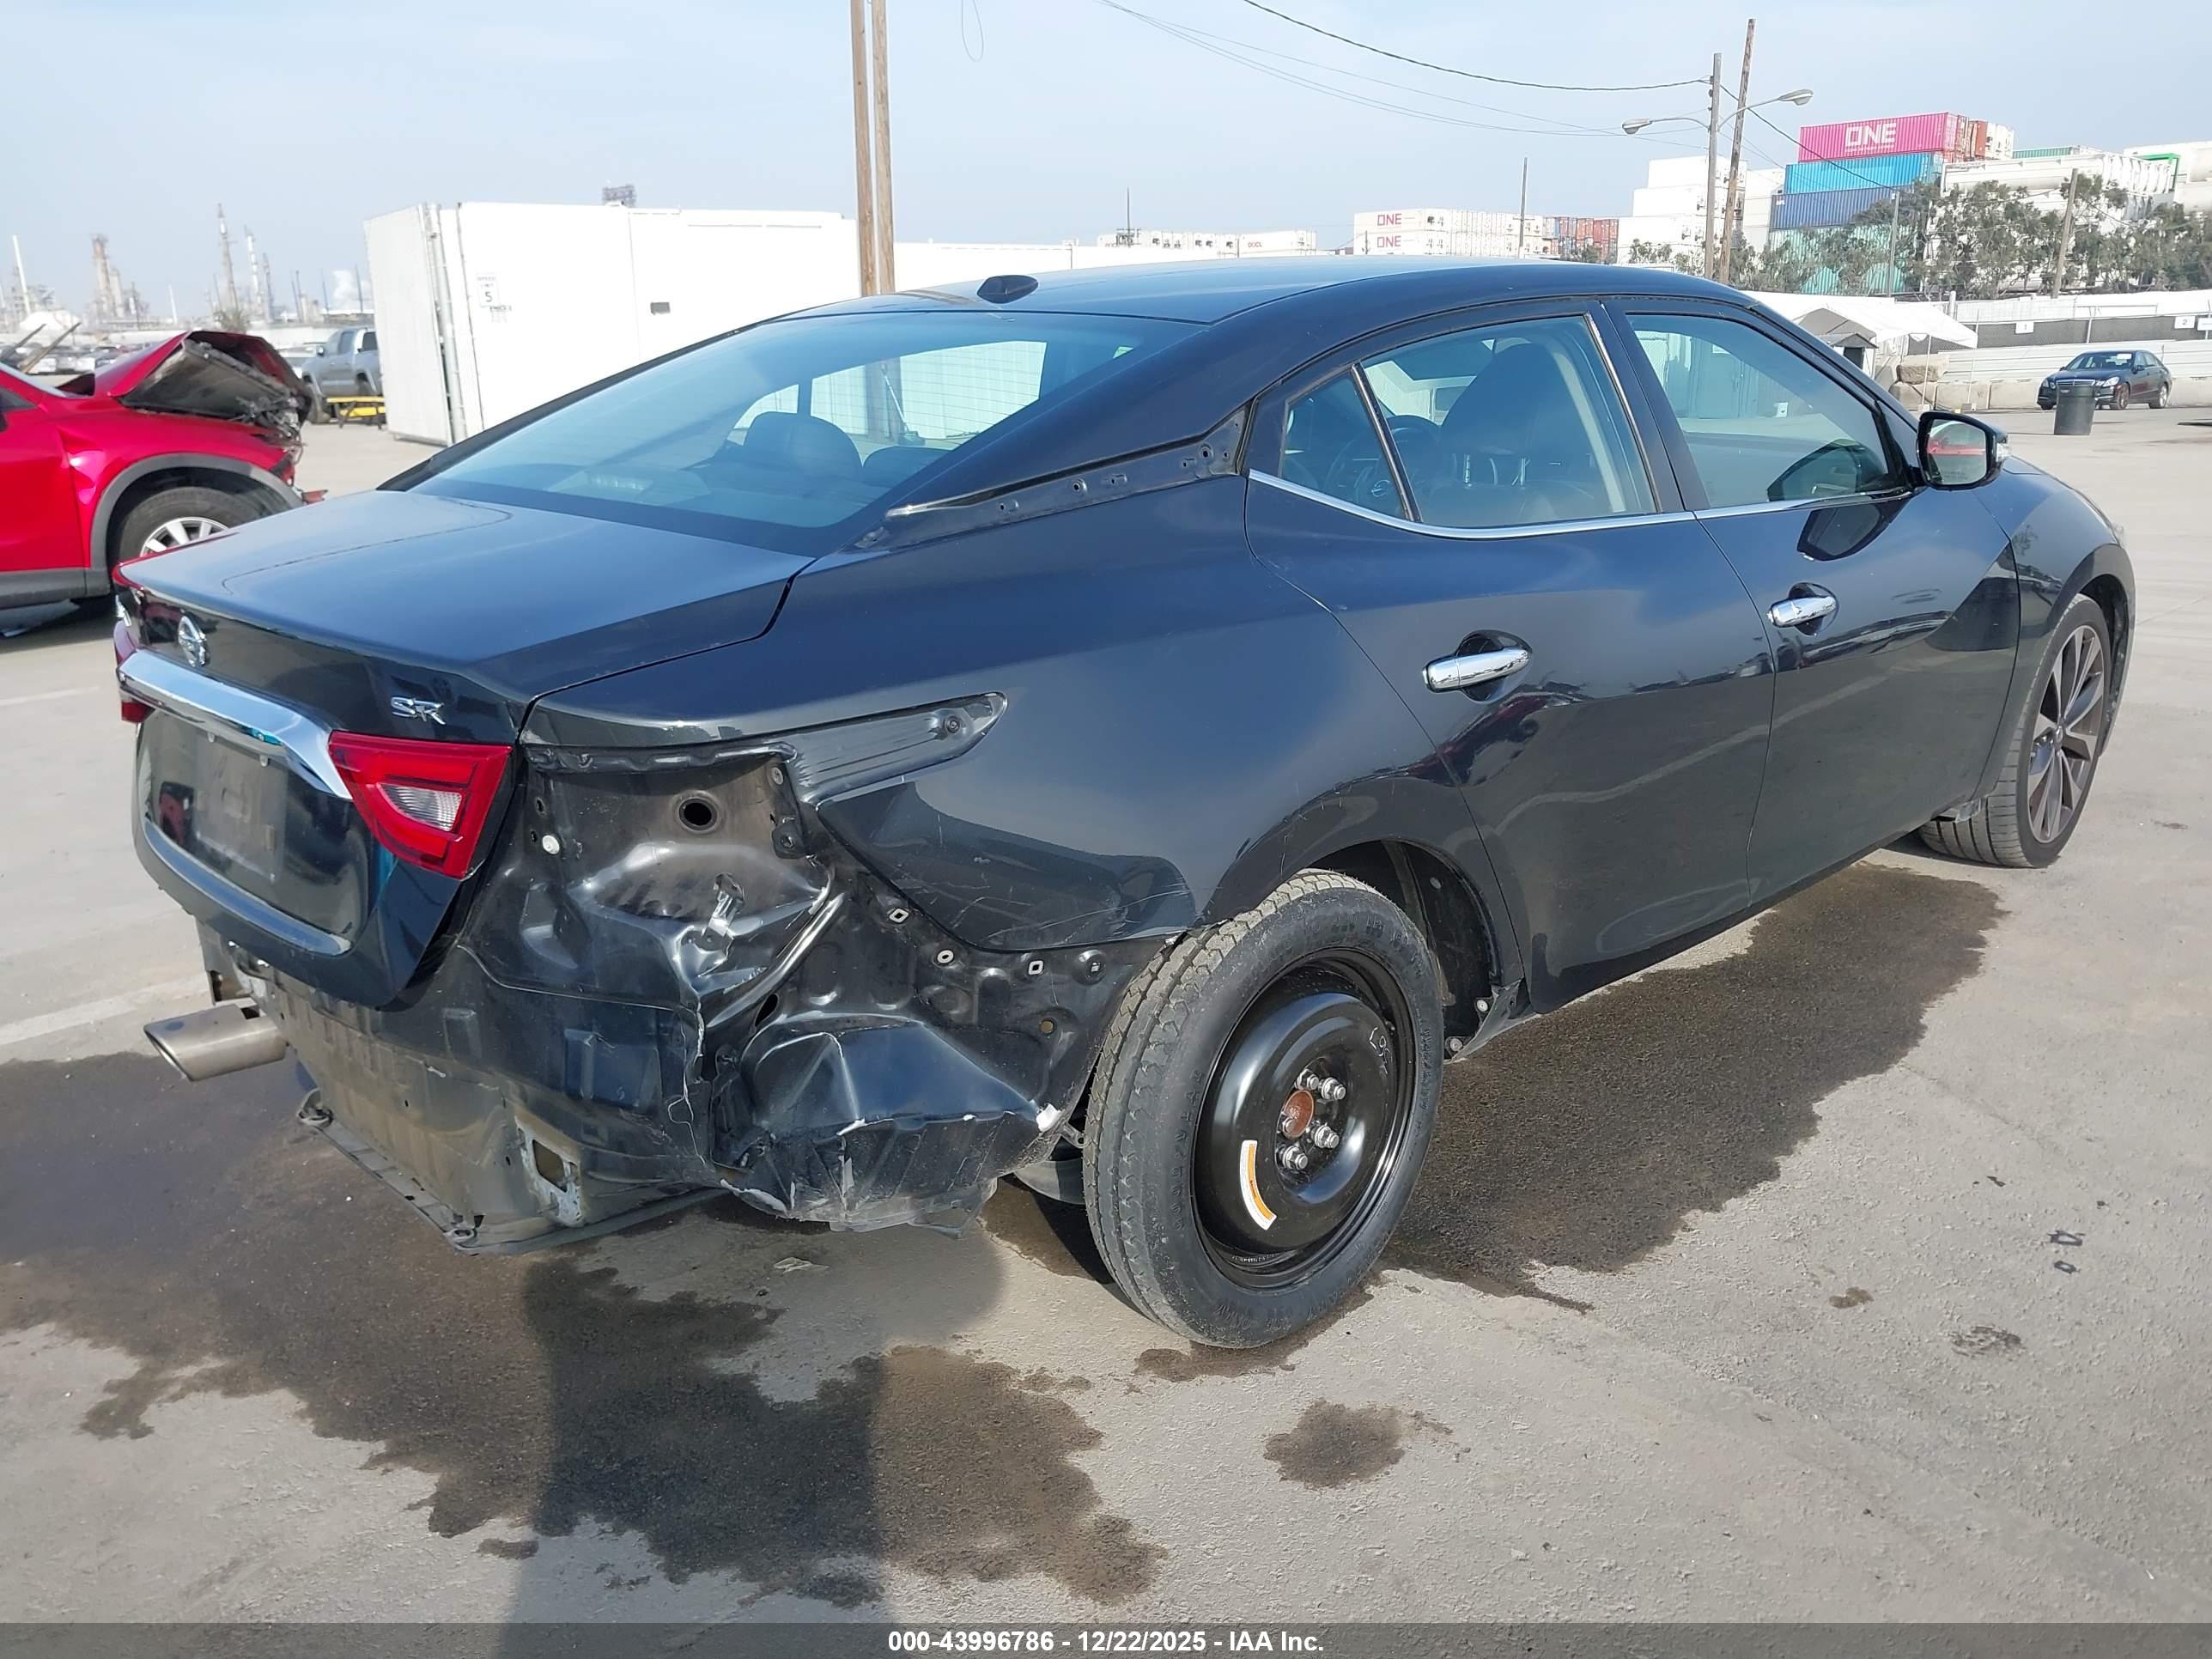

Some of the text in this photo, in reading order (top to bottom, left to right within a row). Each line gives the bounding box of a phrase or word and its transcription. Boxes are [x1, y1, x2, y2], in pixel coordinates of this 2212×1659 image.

[1844, 123, 1897, 147] ONE
[1376, 212, 1402, 226] ONE
[1376, 234, 1402, 248] ONE
[484, 291, 494, 302] 5
[391, 696, 446, 726] SR
